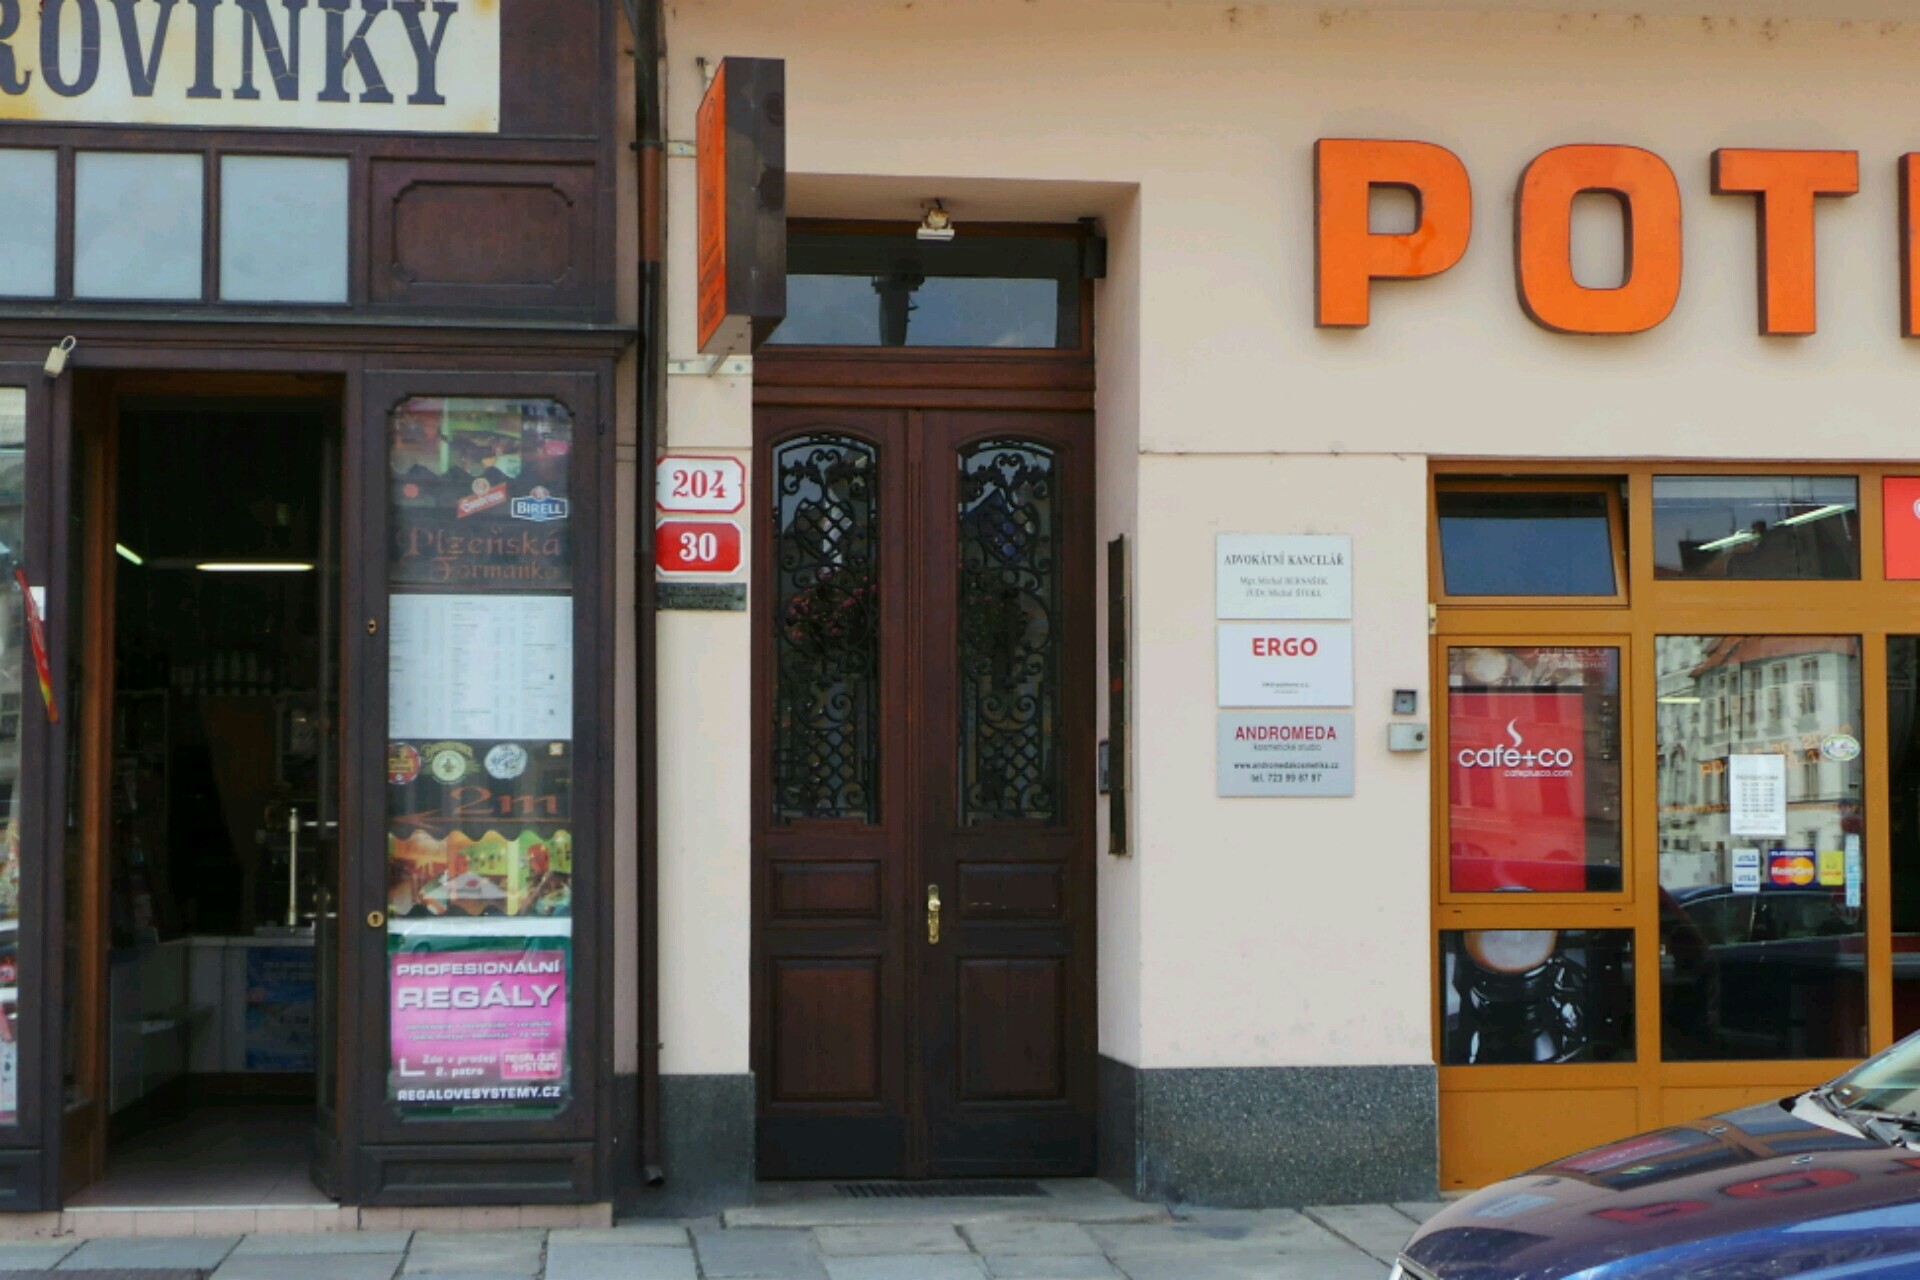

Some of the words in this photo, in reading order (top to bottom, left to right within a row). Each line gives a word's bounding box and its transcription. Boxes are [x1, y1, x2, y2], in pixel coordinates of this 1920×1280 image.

[672, 469, 727, 499] 204
[517, 501, 564, 515] BIRELL
[399, 526, 561, 556] Plzeňská
[679, 531, 718, 562] 30
[1224, 551, 1285, 565] ADVOKÁTNÍ
[1288, 552, 1344, 566] KANCELÁŘ
[1252, 637, 1318, 656] ERGO
[1235, 726, 1337, 740] ANDROMEDA
[450, 786, 558, 815] 2m
[397, 960, 560, 976] PROFESIONÁLNÍ
[397, 982, 559, 1010] REGÁLY
[397, 1086, 561, 1102] REGALOVESYSTEMY.CZ
